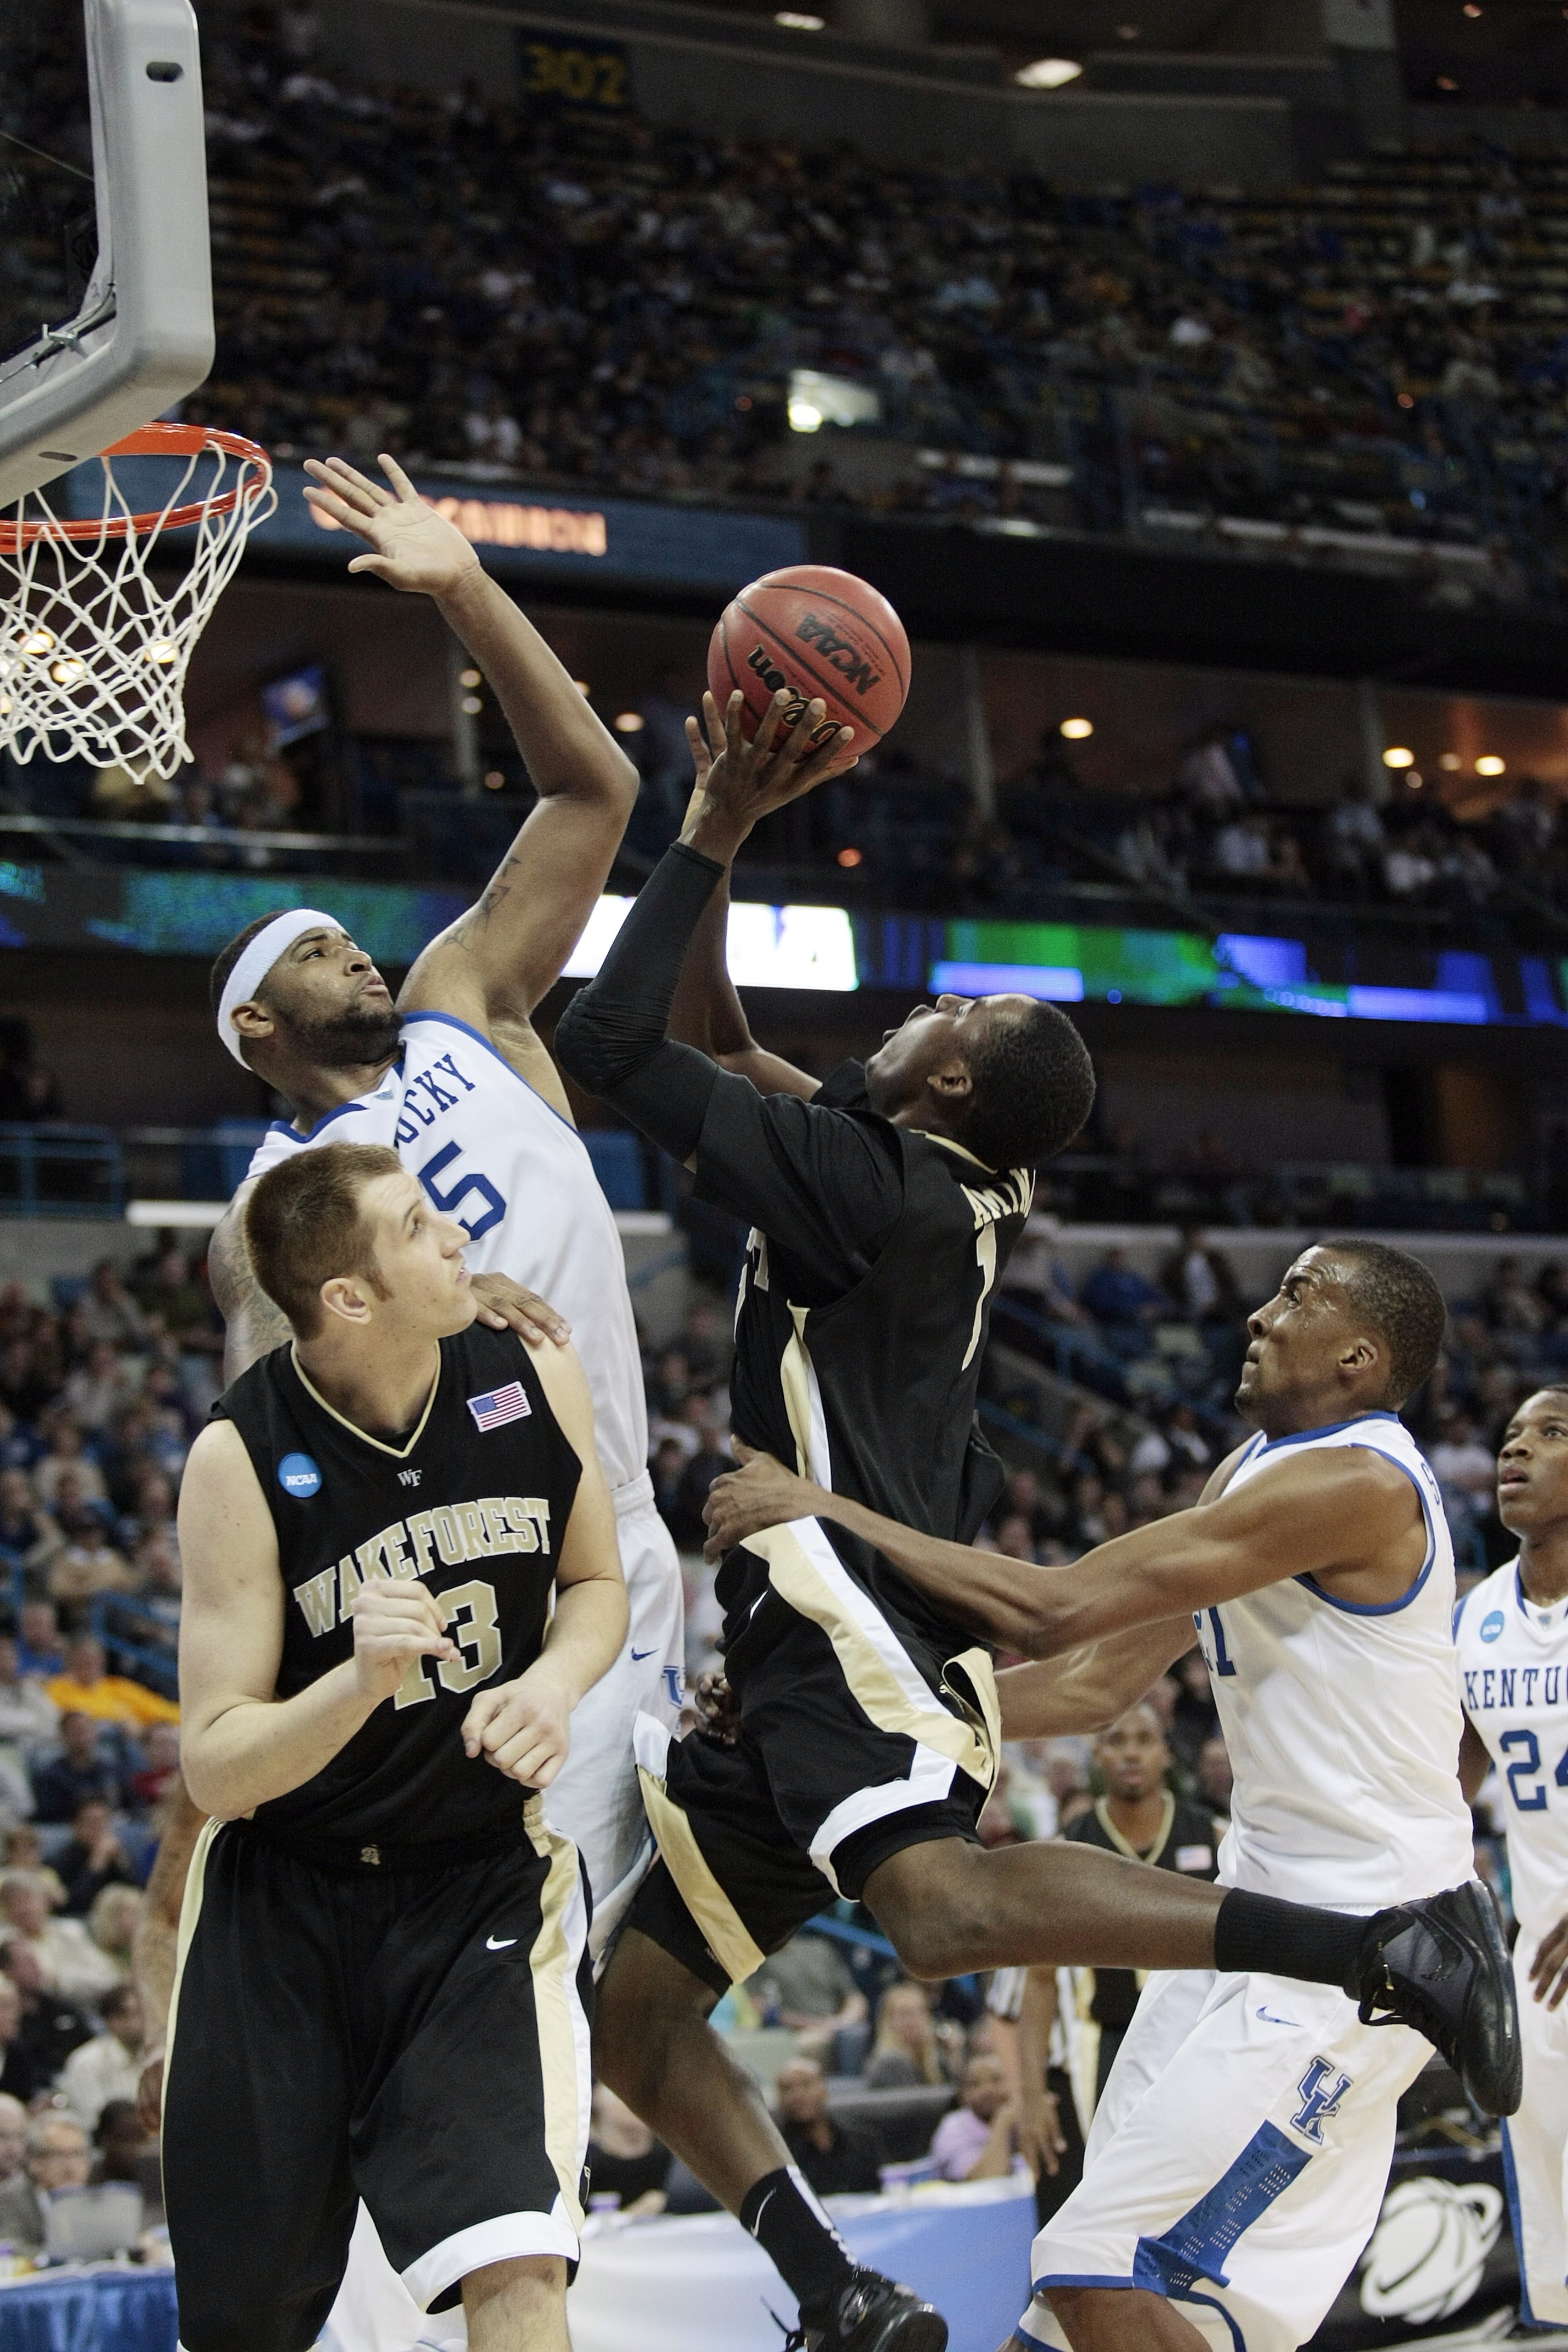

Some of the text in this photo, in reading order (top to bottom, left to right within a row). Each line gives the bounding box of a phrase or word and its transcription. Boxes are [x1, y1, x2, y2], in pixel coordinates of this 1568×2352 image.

[527, 43, 625, 104] 302
[797, 614, 880, 695] NCAA
[417, 1140, 506, 1242] 5
[961, 1221, 997, 1371] 1
[285, 1473, 318, 1487] NCAA
[397, 1469, 423, 1487] WF
[1463, 1665, 1568, 1711] KENTU
[1284, 2056, 1354, 2146] UK
